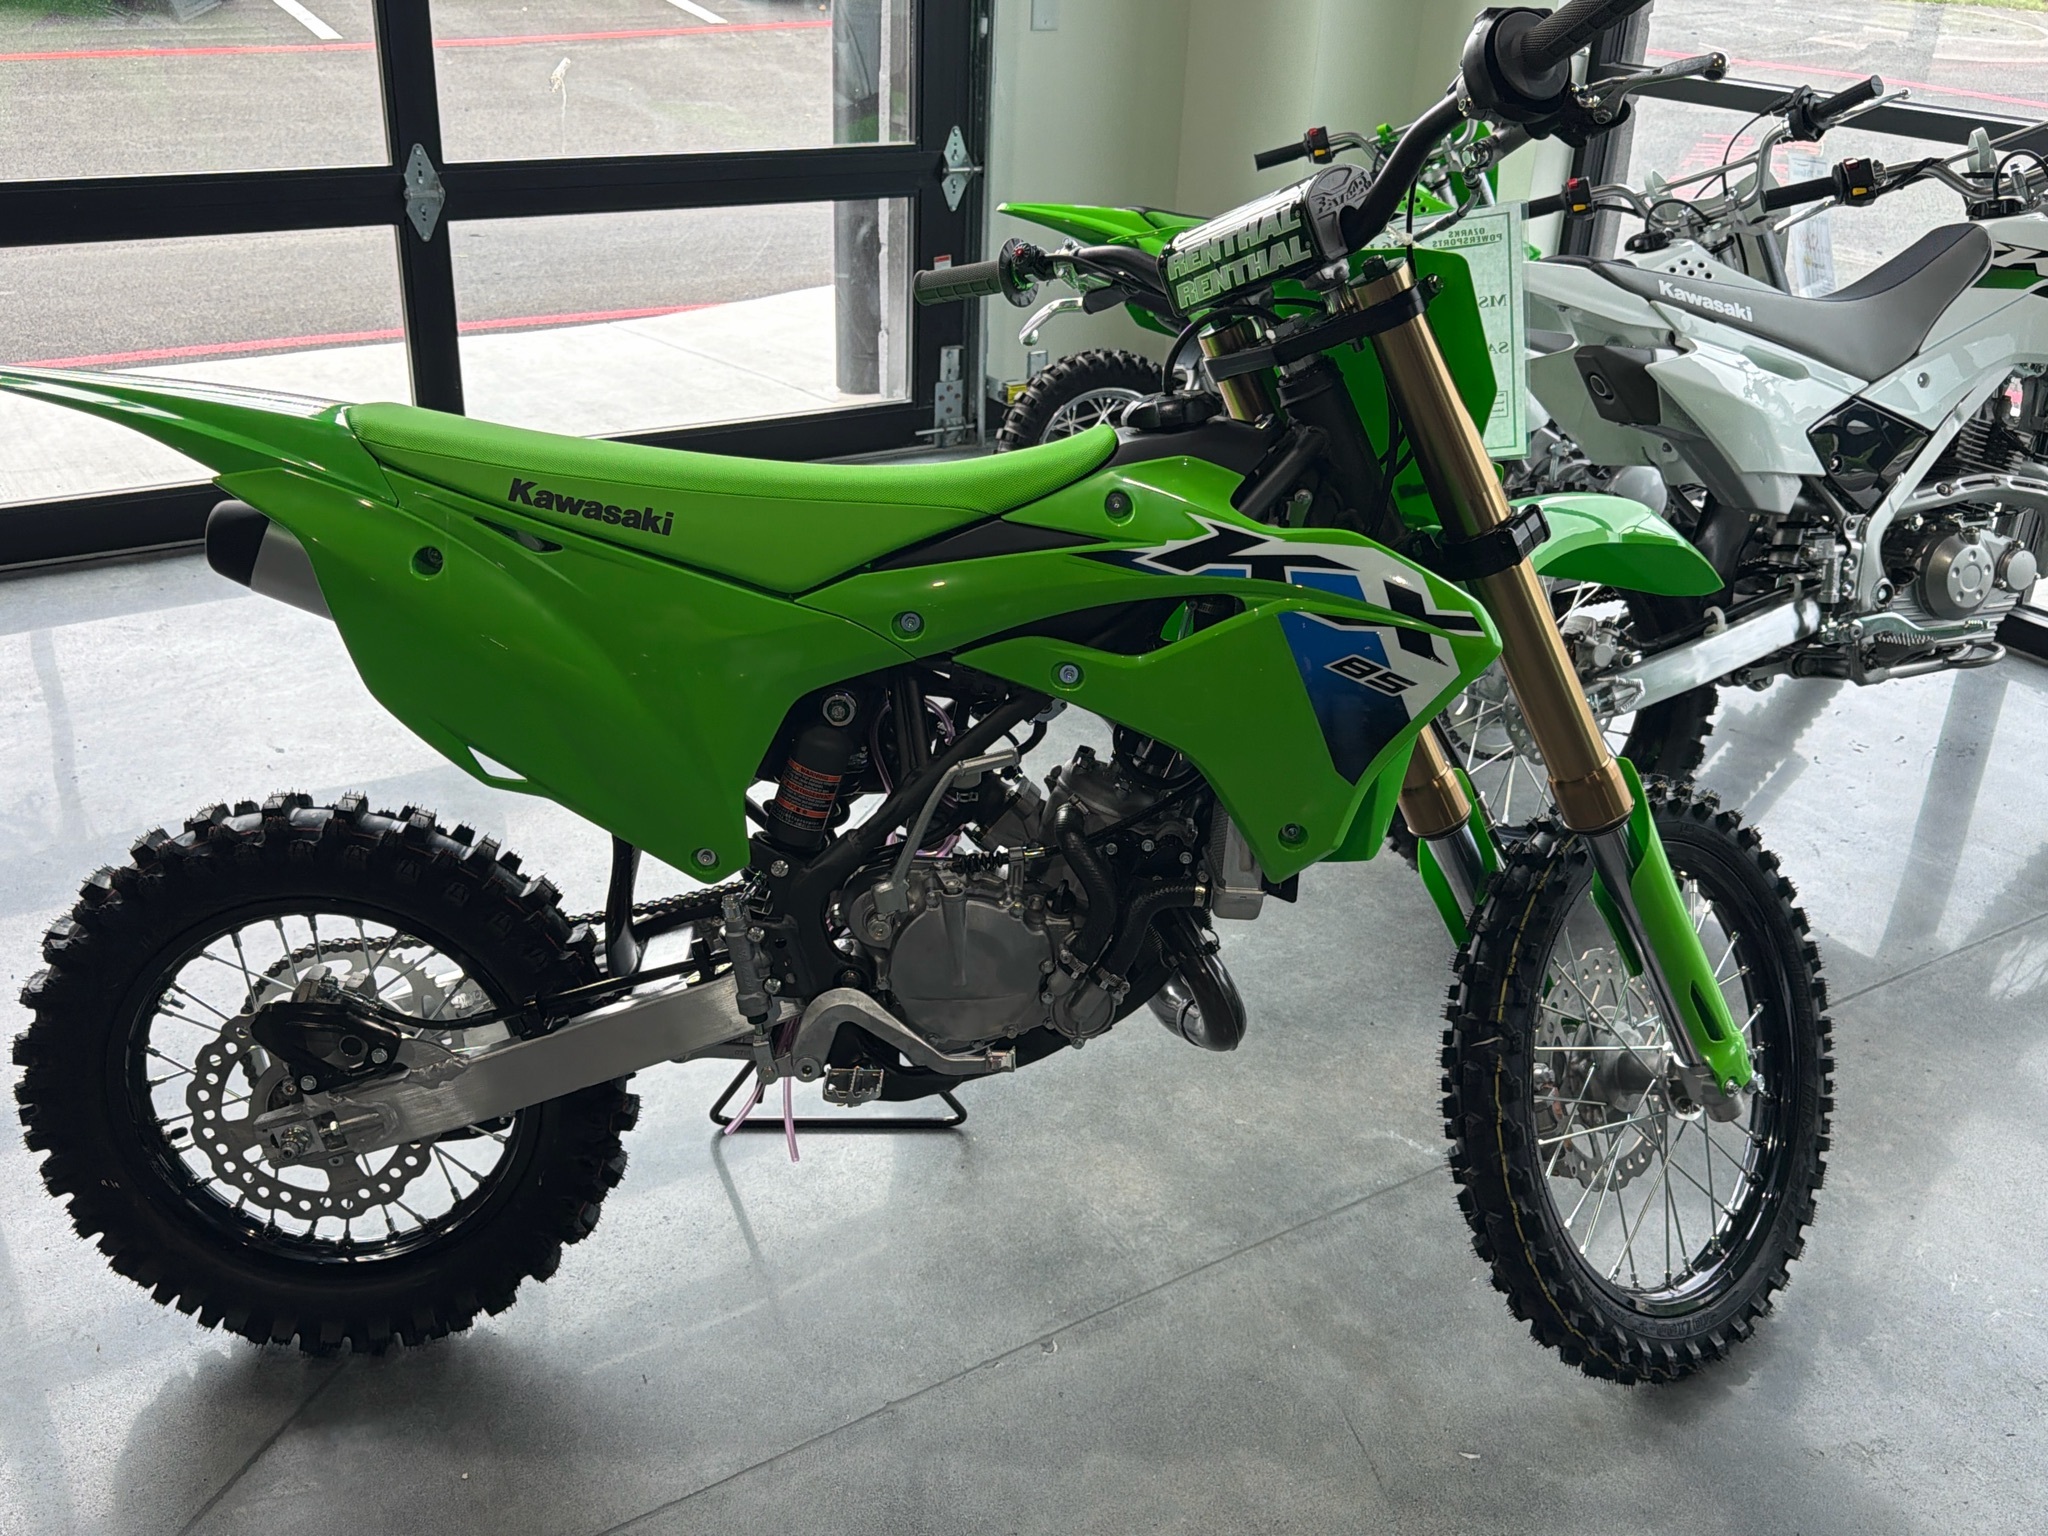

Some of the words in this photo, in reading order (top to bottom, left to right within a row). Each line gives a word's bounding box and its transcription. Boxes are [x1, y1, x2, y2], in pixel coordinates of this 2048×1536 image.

[1167, 204, 1301, 281] RENTHAL
[1176, 235, 1312, 310] RENTHAL
[1658, 279, 1753, 322] Kawasaki
[508, 477, 675, 536] Kawasaki
[1328, 656, 1419, 695] 85
